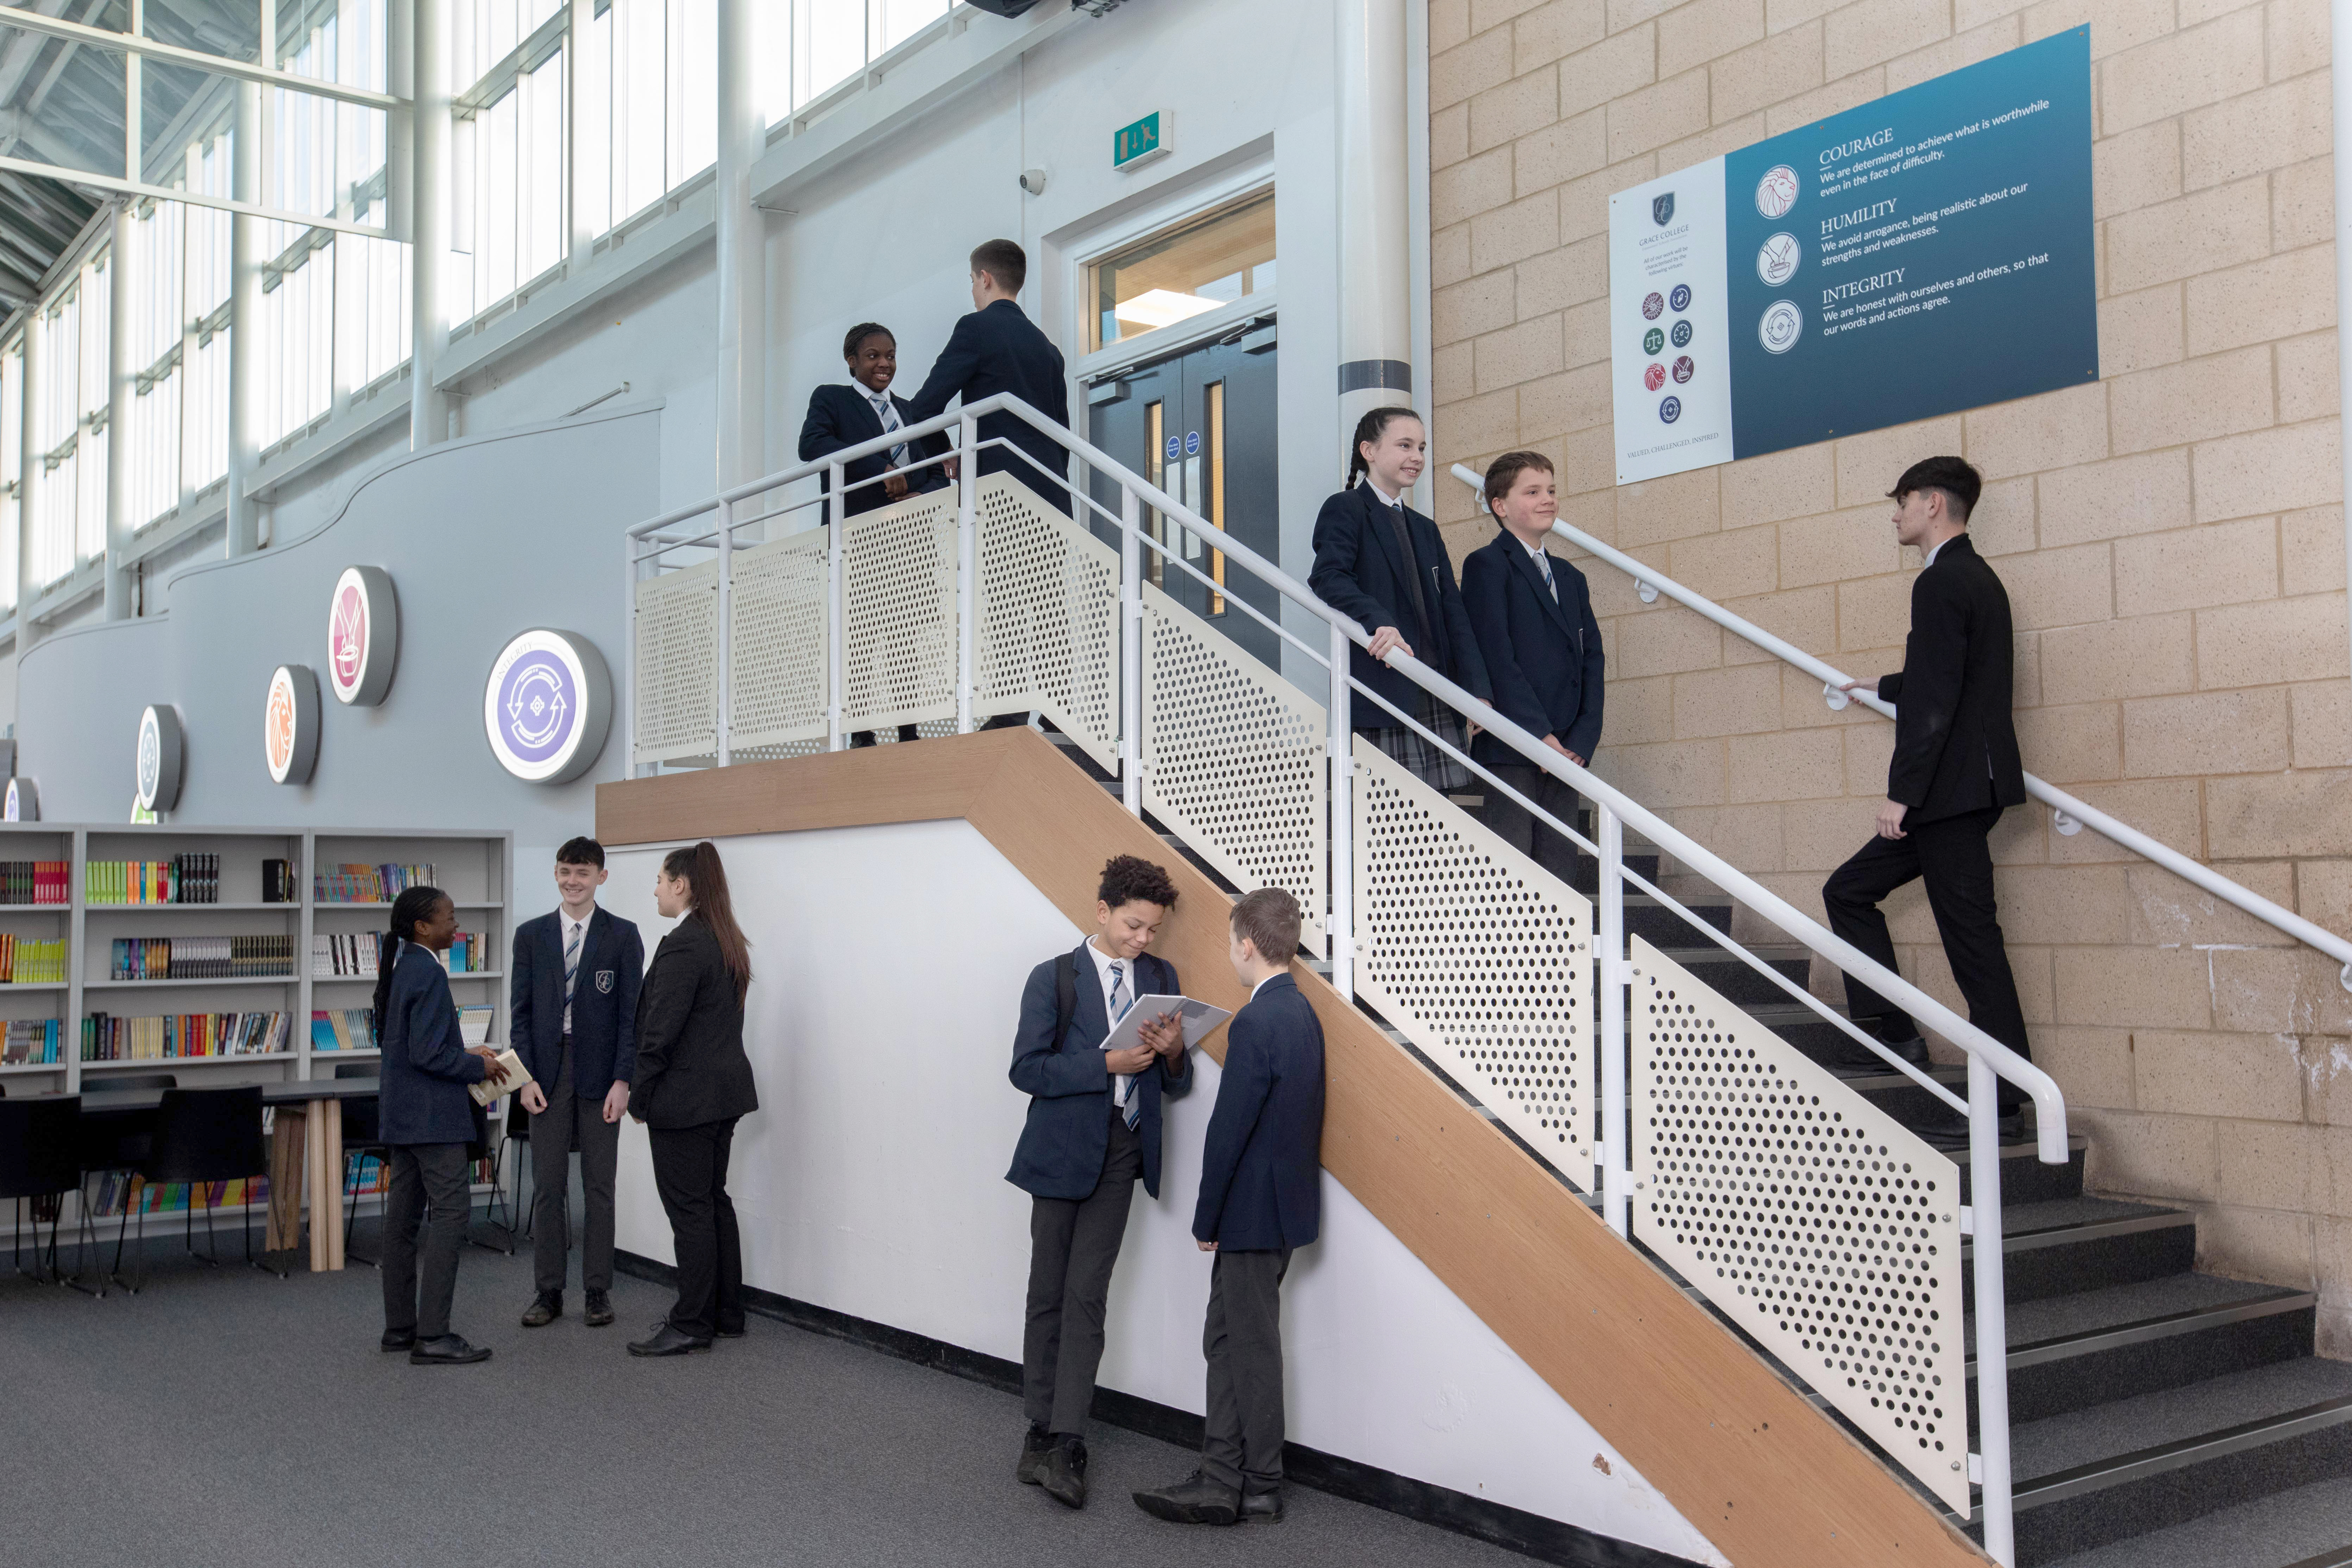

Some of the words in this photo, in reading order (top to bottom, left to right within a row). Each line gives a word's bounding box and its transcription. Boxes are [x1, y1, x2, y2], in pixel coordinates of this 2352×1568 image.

[1820, 172, 1835, 183] We
[1837, 168, 1850, 178] are
[1853, 147, 1903, 172] determined
[1906, 146, 1915, 155] to
[1918, 133, 1953, 151] achieve
[1955, 122, 1979, 138] what
[1982, 120, 1989, 129] is
[1992, 100, 2049, 125] worthwhile
[1820, 128, 1893, 164] COURAGE
[1820, 185, 1841, 197] even
[1843, 178, 1851, 189] in
[1853, 176, 1867, 186] the
[1870, 169, 1888, 181] face
[1891, 162, 1900, 174] of
[1903, 151, 1944, 170] difficulty.
[1821, 198, 1897, 234] HUMILITY
[1822, 241, 1836, 252] We
[1838, 232, 1861, 247] avoid
[1864, 221, 1910, 240] arrogance,
[1913, 211, 1938, 225] being
[1941, 198, 1976, 216] realistic
[1979, 188, 2008, 205] about
[2011, 183, 2028, 195] our
[1639, 234, 1659, 246] GRACE
[1660, 224, 1689, 239] COLLEGE
[1822, 248, 1862, 266] strengths
[1864, 240, 1880, 254] and
[1882, 226, 1938, 248] weaknesses.
[1645, 258, 1673, 270] characterised
[1648, 267, 1667, 276] following
[1823, 268, 1905, 303] INTEGRITY
[1823, 311, 1838, 322] We
[1841, 308, 1854, 317] are
[1856, 297, 1886, 313] honest
[1888, 291, 1908, 304] with
[1911, 280, 1954, 298] ourselves
[1957, 272, 1974, 286] and
[1977, 265, 2011, 280] others,
[2014, 261, 2025, 270] so
[2028, 253, 2048, 266] that
[1824, 326, 1838, 335] our
[1840, 317, 1867, 331] words
[1869, 311, 1885, 324] and
[1887, 304, 1920, 319] actions
[1922, 296, 1950, 310] agree.
[1628, 449, 1650, 459] VALUED,
[1651, 439, 1690, 453] CHALLENGED,
[1692, 433, 1718, 443] INSPIRED
[497, 642, 532, 680] INTEGRITY
